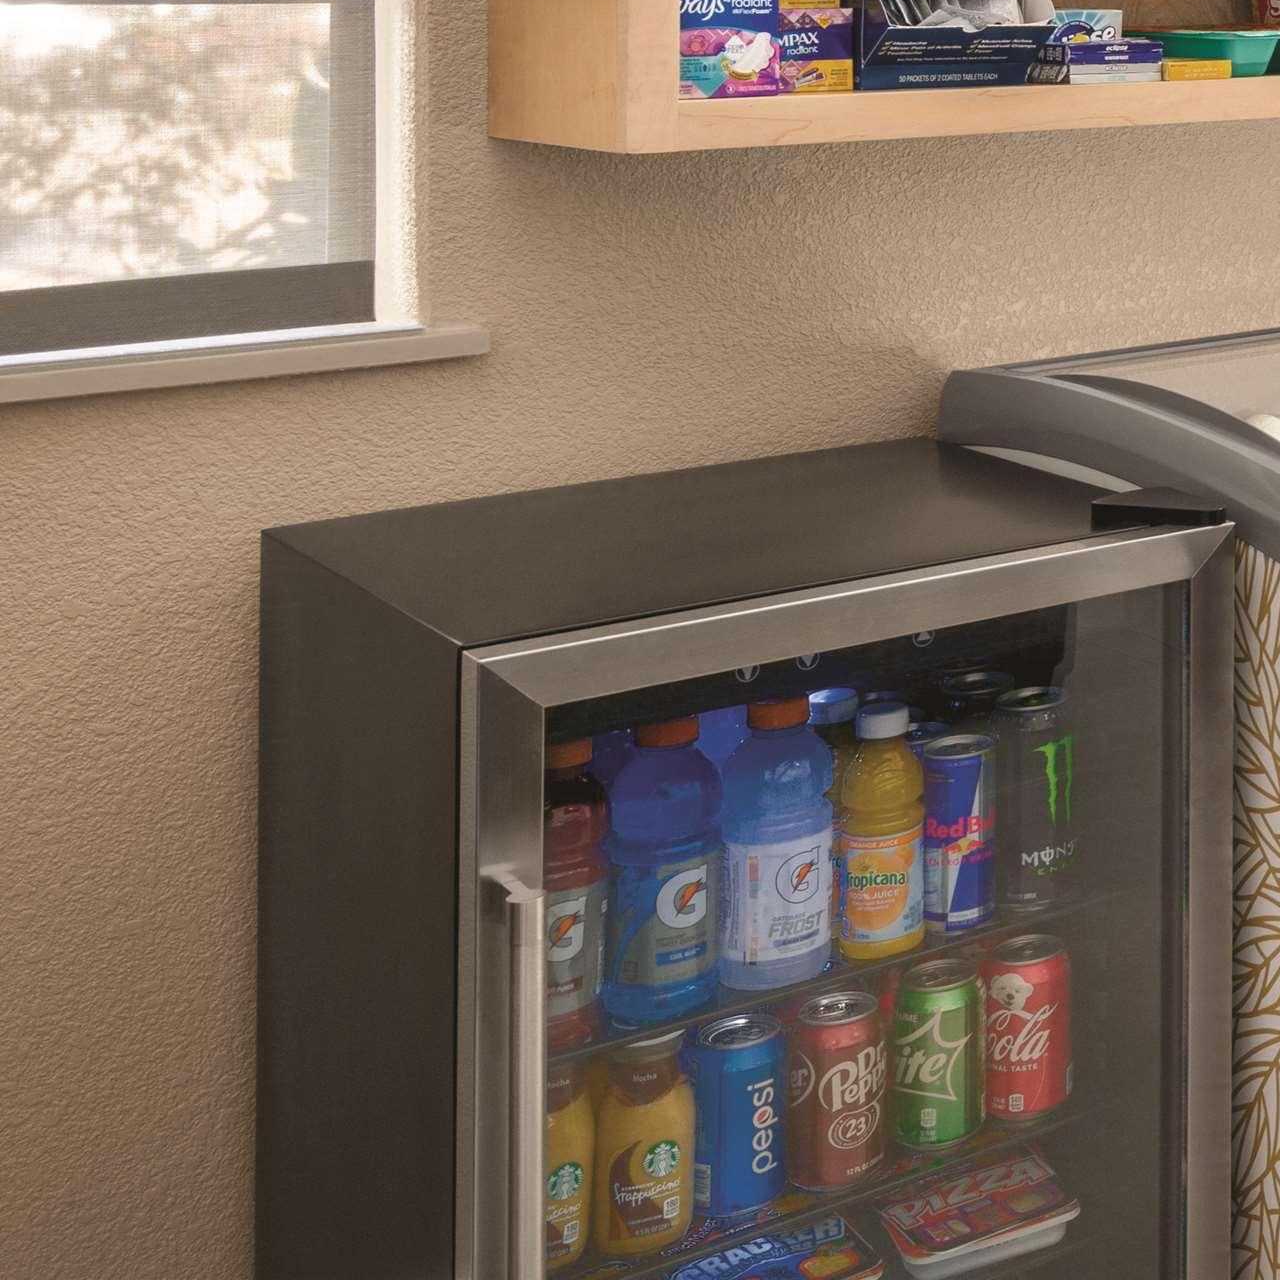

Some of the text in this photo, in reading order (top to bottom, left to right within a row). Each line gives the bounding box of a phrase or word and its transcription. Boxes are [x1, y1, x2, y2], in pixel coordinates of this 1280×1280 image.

[779, 31, 820, 48] MPAX
[962, 73, 984, 81] TABLETS
[926, 816, 964, 838] Red
[846, 872, 906, 891] Tropicana
[871, 891, 900, 900] JUICE
[768, 909, 825, 938] FROST
[1010, 1063, 1039, 1073] TASTE
[747, 1076, 779, 1176] pepsi
[846, 1116, 866, 1139] 23
[883, 1157, 1052, 1228] PIZZA
